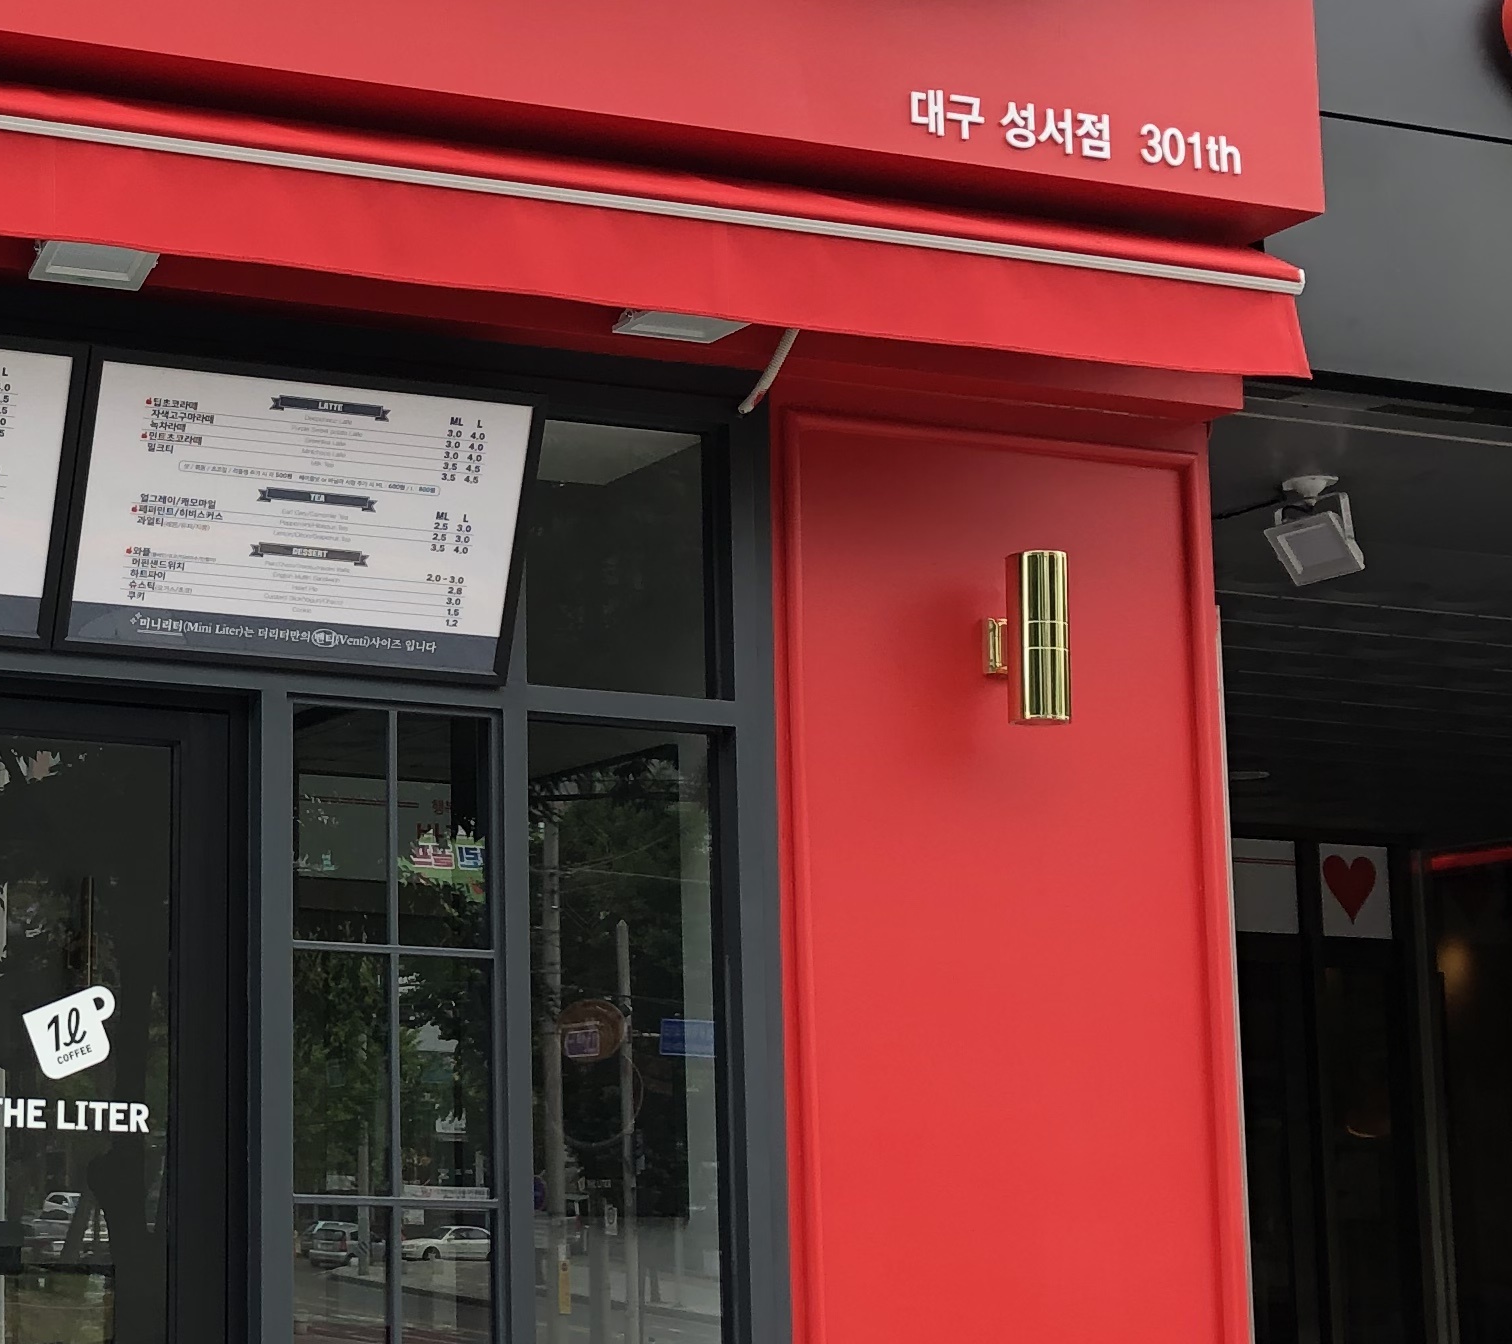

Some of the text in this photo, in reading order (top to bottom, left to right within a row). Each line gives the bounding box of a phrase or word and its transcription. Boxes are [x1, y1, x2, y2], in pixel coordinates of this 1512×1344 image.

[910, 89, 1242, 175] 대구 성서점 301th
[2, 367, 8, 376] L
[318, 401, 343, 412] LATTE
[450, 417, 483, 428] ML L
[447, 429, 485, 440] 3.0 4.0
[310, 493, 325, 502] TEA
[436, 511, 469, 522] ML L
[434, 522, 471, 532] 2.5 3.0
[405, 640, 437, 654] 입니다
[57, 1044, 93, 1065] COFFEE
[56, 1099, 149, 1133] LITER
